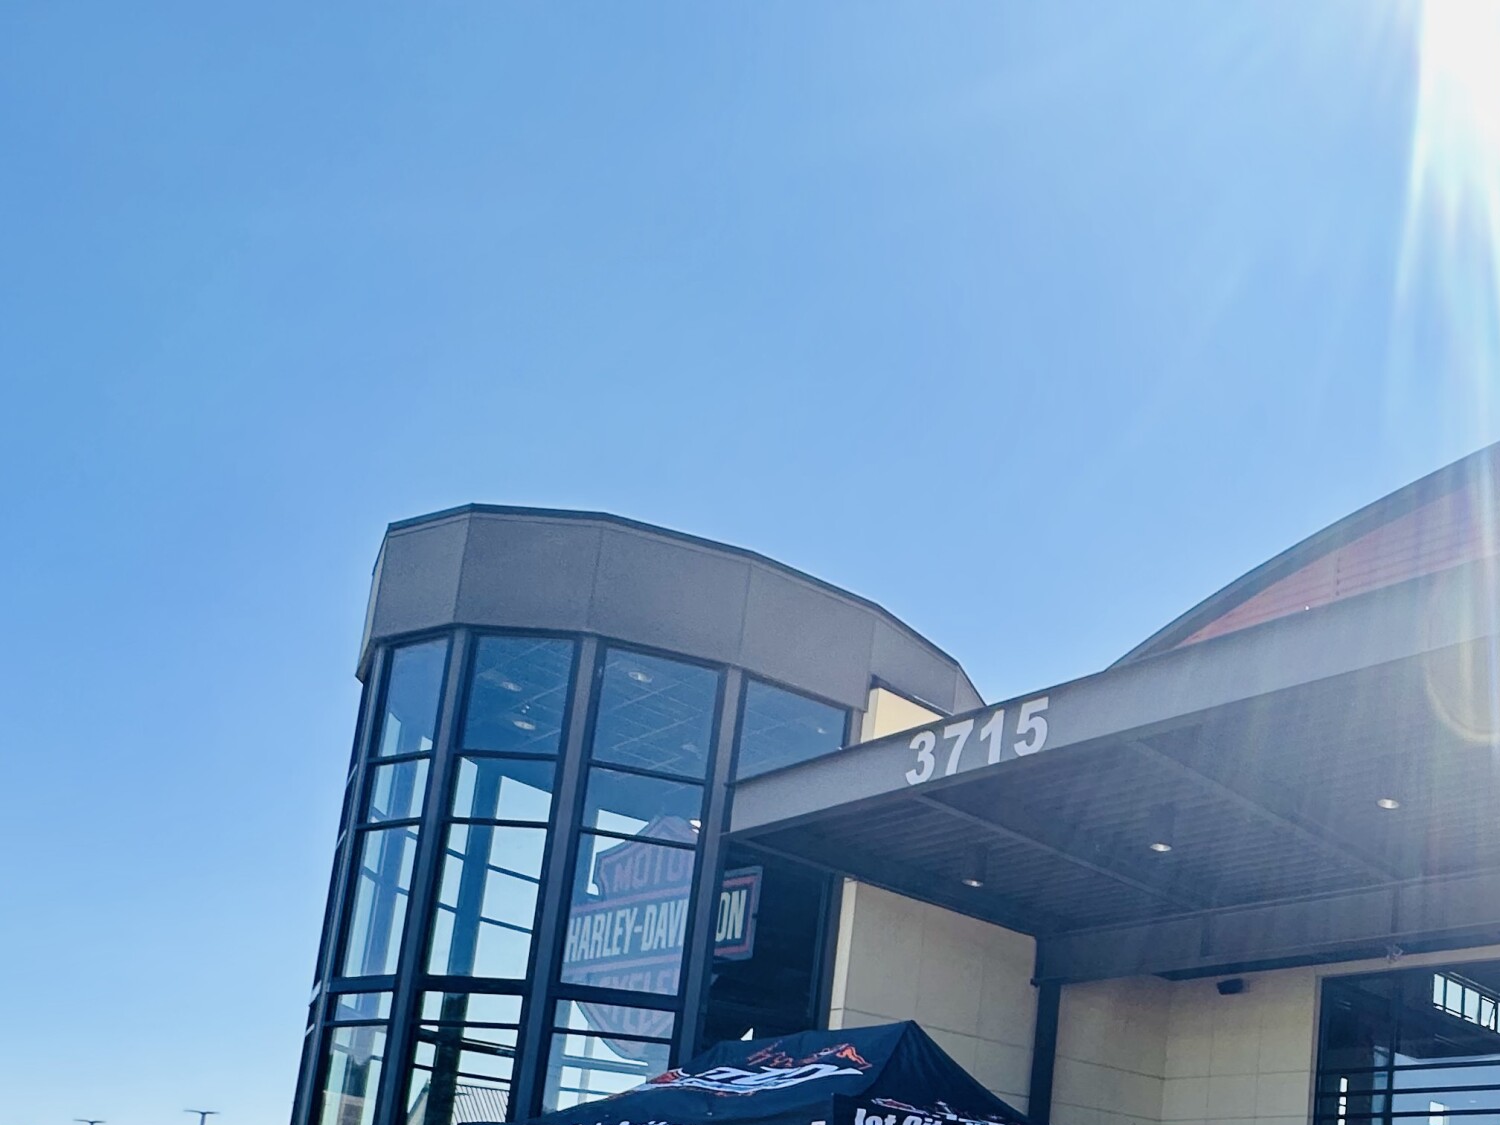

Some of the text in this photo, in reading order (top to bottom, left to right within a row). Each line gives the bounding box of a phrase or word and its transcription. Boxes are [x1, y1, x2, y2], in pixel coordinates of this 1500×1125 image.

[905, 696, 1049, 786] 3715
[613, 845, 698, 893] MOTO
[563, 889, 748, 963] HARLEY-DAVION
